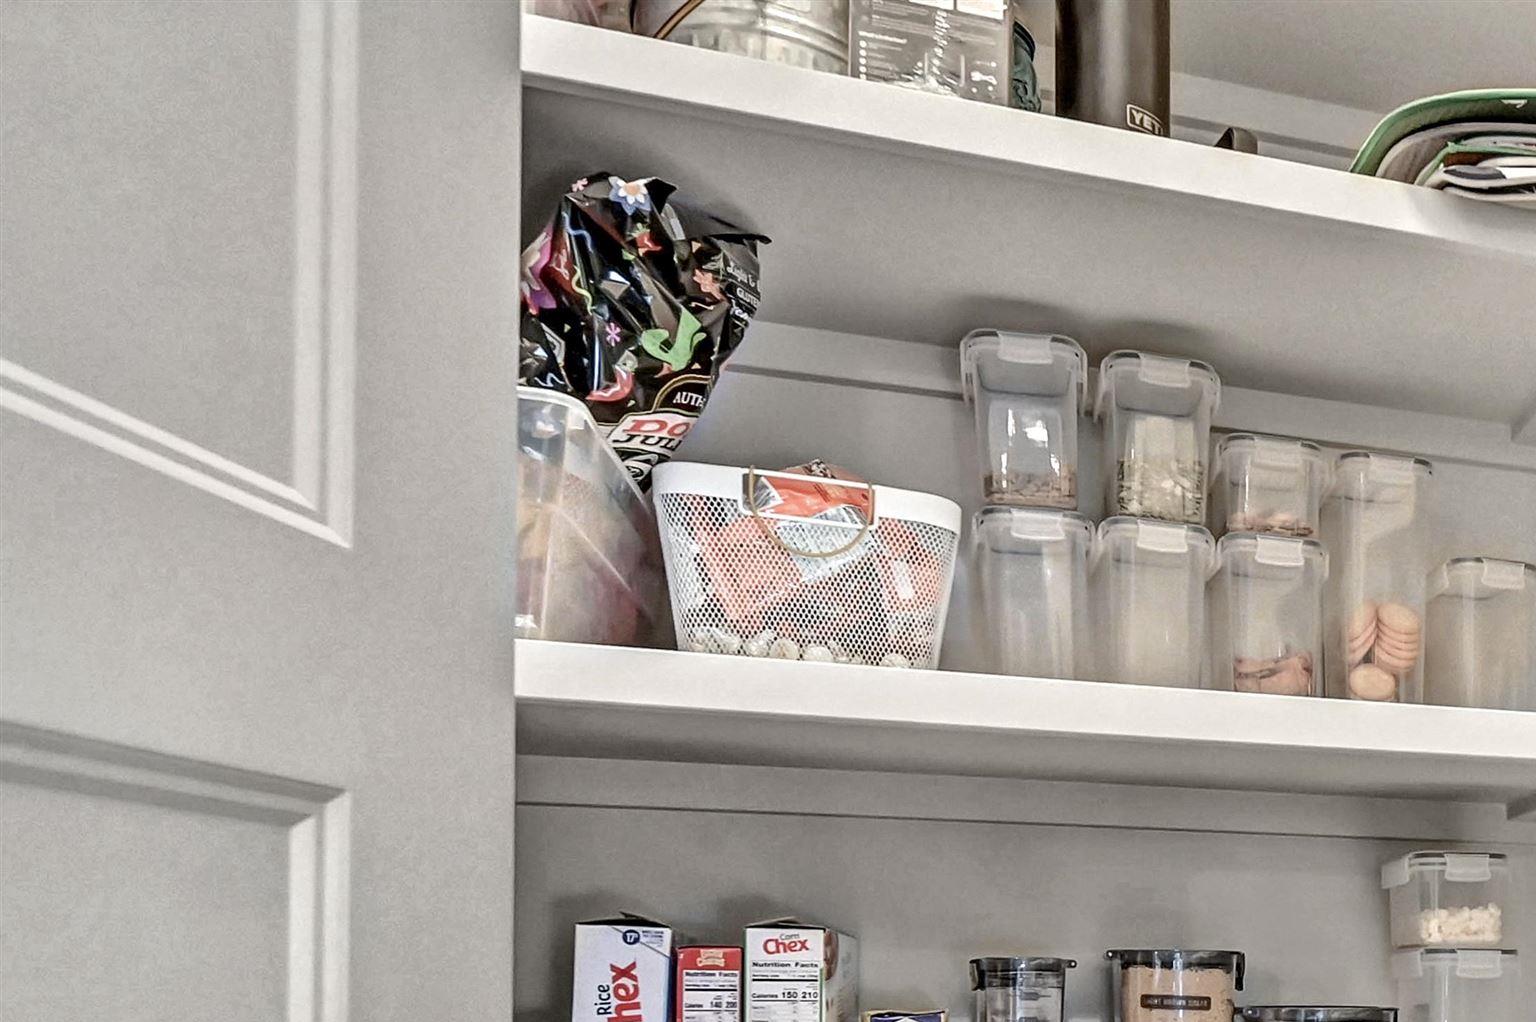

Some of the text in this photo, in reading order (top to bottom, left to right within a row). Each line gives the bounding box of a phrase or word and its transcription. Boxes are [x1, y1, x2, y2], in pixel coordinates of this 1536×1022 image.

[763, 938, 810, 955] Chex
[597, 984, 612, 1016] Rice
[782, 991, 798, 999] 150
[801, 991, 819, 999] 210
